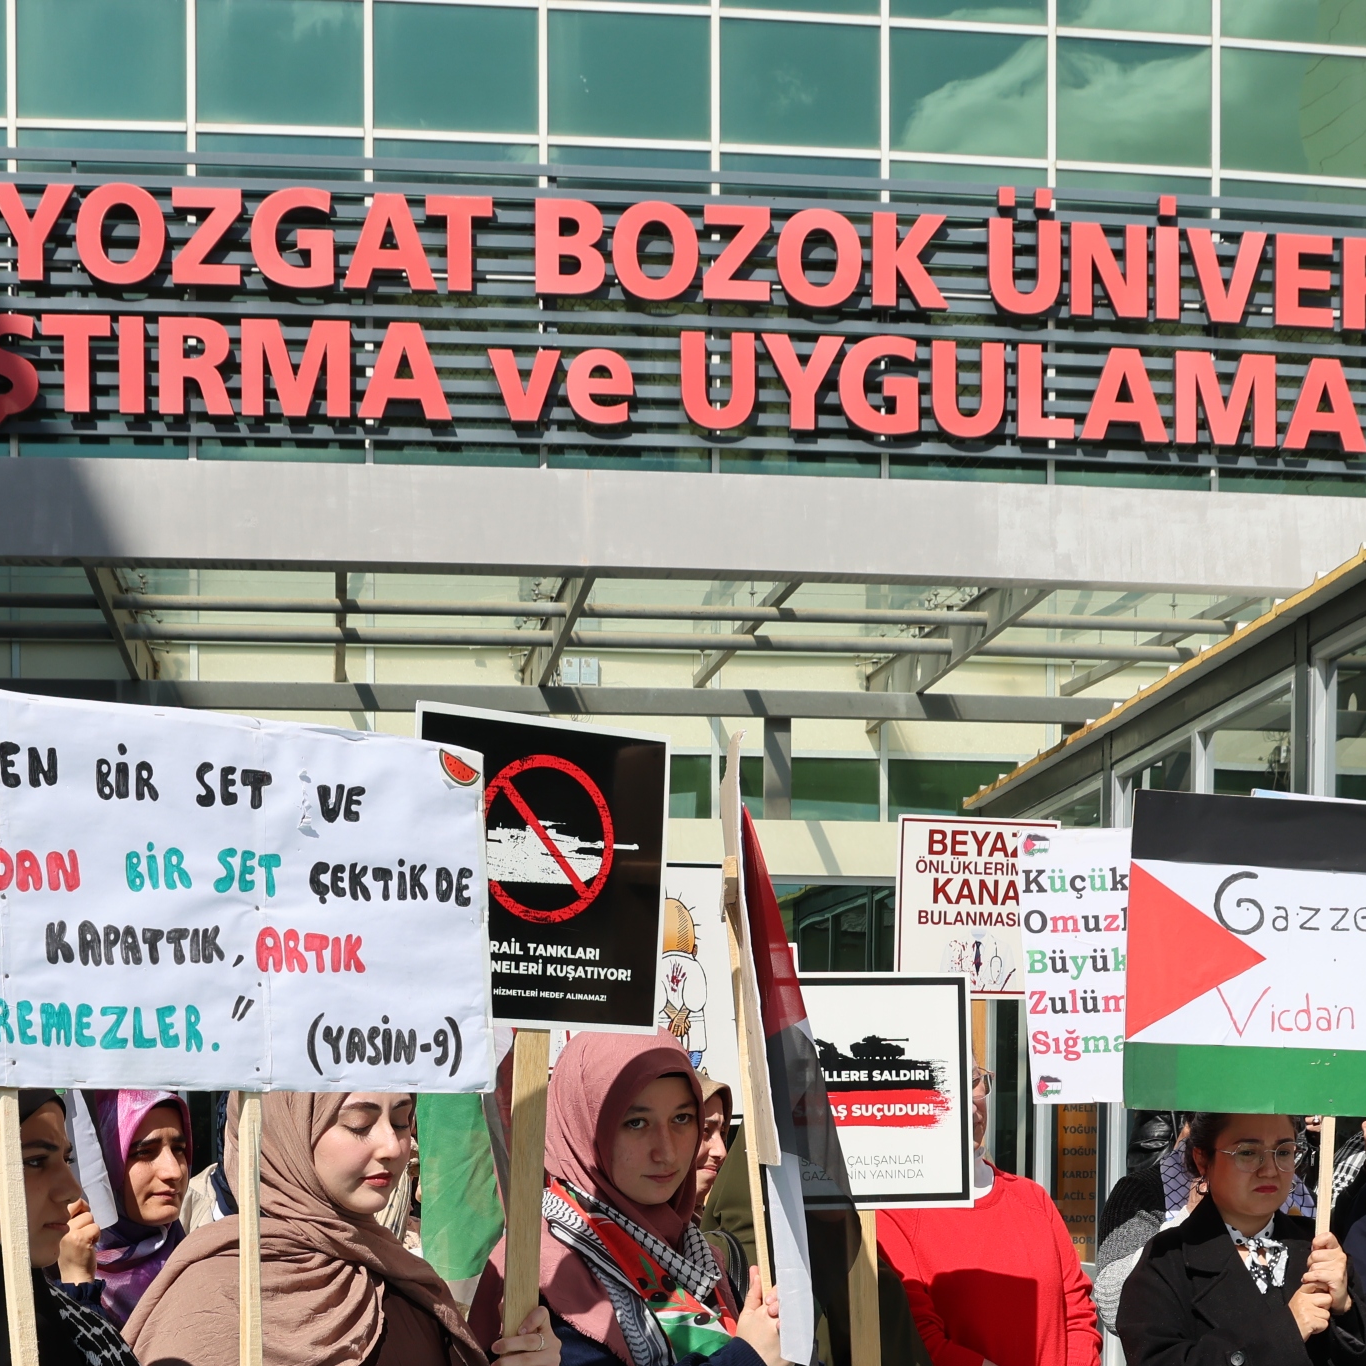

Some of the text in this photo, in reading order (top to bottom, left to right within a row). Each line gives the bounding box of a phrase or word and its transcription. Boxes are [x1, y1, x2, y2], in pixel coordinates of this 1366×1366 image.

[533, 196, 949, 312] BOZOK
[485, 346, 635, 426] ve
[95, 742, 159, 802] BİR
[195, 764, 273, 811] SET
[316, 783, 366, 824] VE
[125, 840, 192, 893] BİR
[213, 847, 282, 899] SET
[1022, 867, 1129, 899] Küçük
[45, 919, 245, 968] KAPATTIK,
[256, 925, 367, 976] ARTIK
[527, 943, 600, 960] TANKLARI
[546, 963, 632, 981] KUŞATIYOR!
[493, 986, 607, 1002] HİZMETLERİ HEDEF ALINAMAZ!
[1215, 985, 1355, 1038] Vicdan
[872, 1069, 930, 1082] SALDIRI
[851, 1103, 934, 1120] SUÇUDUR!
[846, 1154, 924, 1168] ÇALIŞANLARI
[869, 1168, 924, 1180] YANINDA
